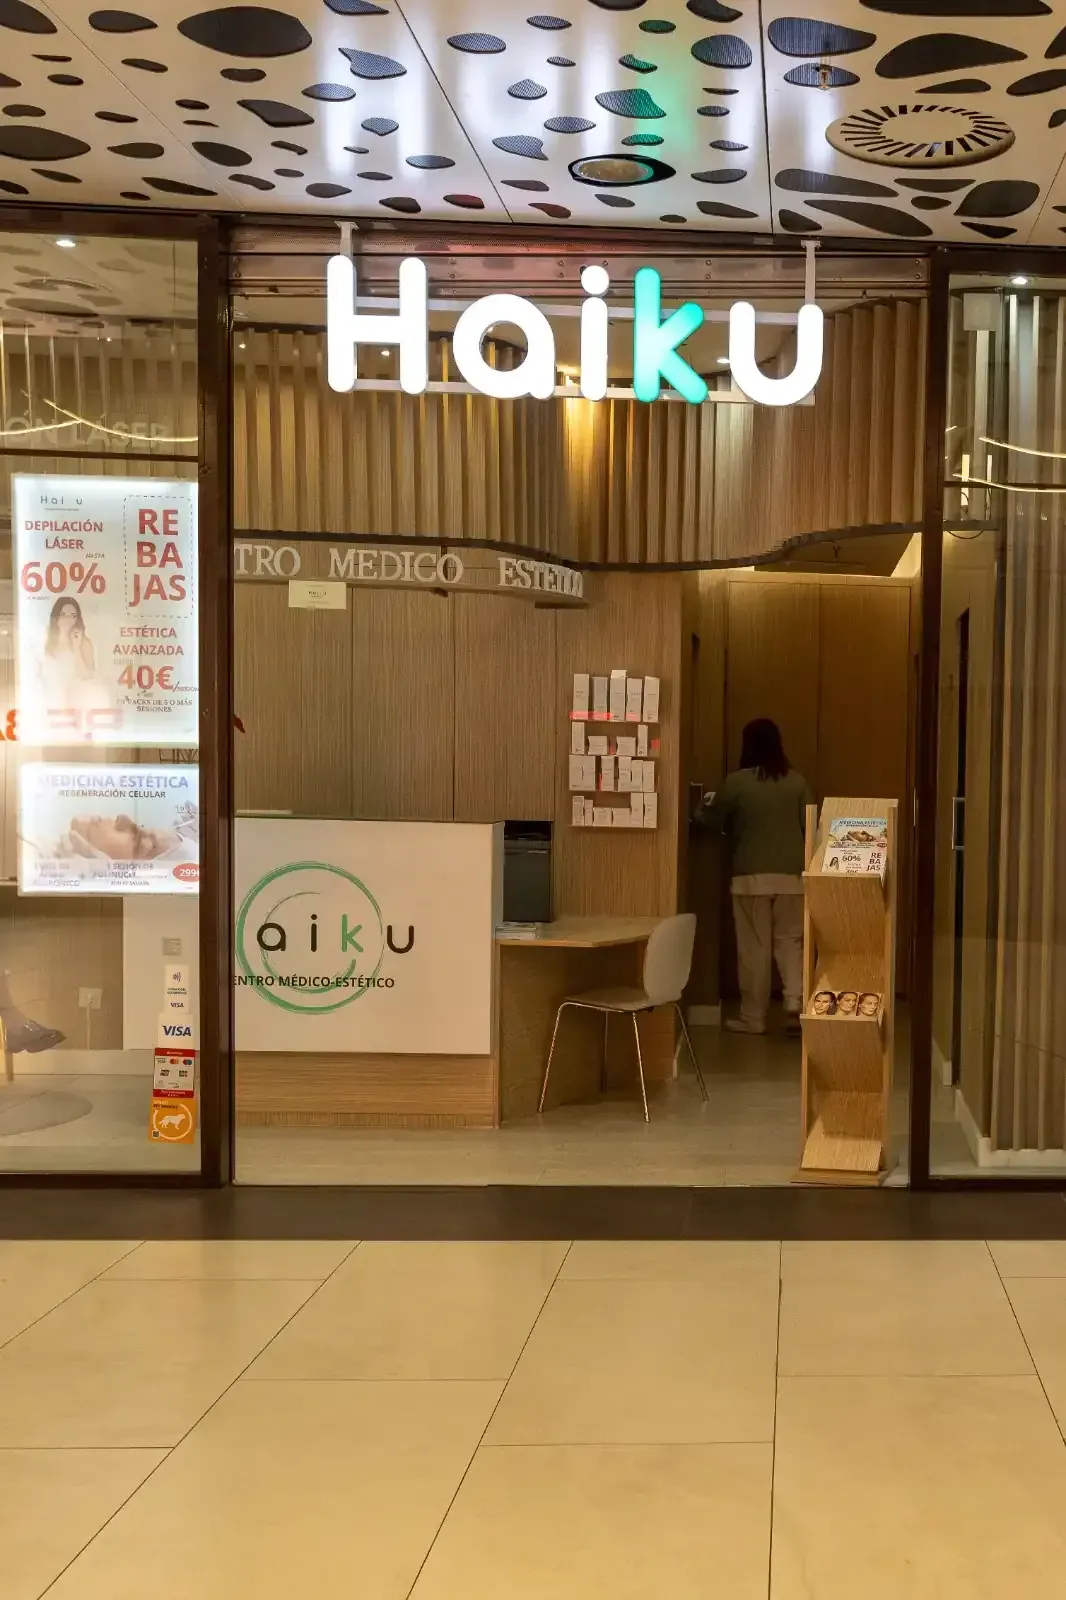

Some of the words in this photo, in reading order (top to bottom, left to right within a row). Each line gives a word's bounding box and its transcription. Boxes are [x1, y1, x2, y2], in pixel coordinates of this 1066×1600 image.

[326, 255, 825, 406] Haiku
[40, 495, 83, 505] Haiu
[25, 518, 103, 533] DEPILACIÓN
[138, 508, 179, 536] RE
[45, 536, 84, 550] LÁSER
[136, 541, 184, 569] BA
[328, 547, 464, 584] MEDICO
[21, 561, 106, 595] 60%
[129, 574, 187, 608] JAS
[120, 625, 178, 639] ESTÉTICA
[113, 643, 184, 657] AVANZADA
[37, 775, 115, 789] MEDICINA
[120, 773, 189, 789] ESTÉTICA
[59, 788, 126, 798] REGENERACIÓN
[128, 790, 166, 799] CELULAR
[278, 974, 395, 989] MÉDICO-ESTÉTICO
[162, 1025, 192, 1037] VISA
